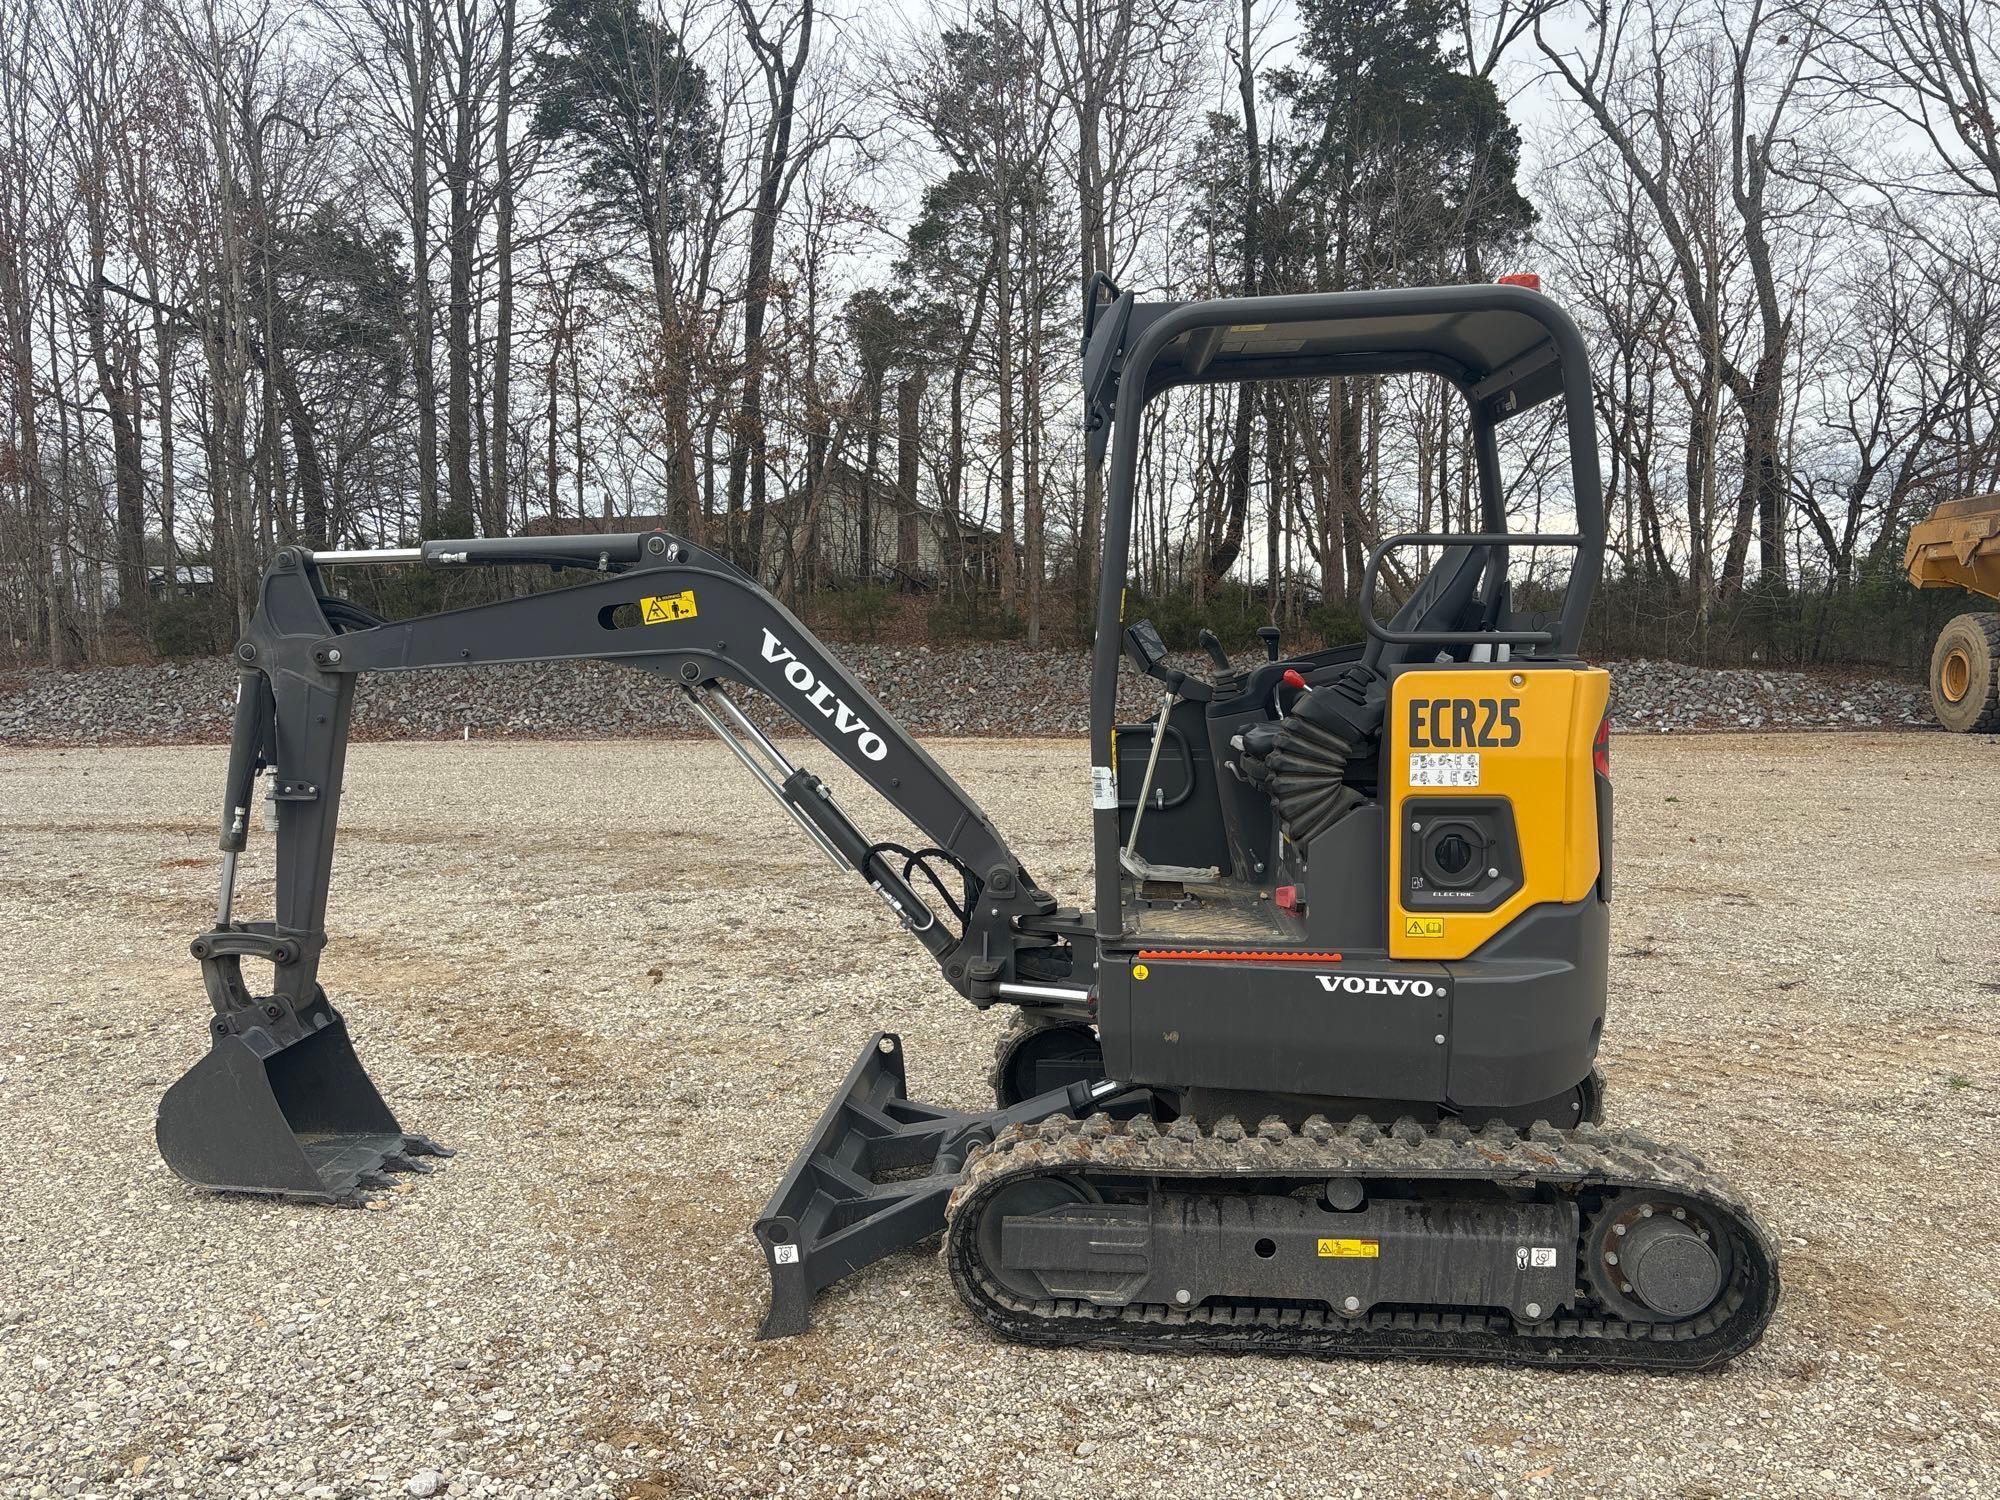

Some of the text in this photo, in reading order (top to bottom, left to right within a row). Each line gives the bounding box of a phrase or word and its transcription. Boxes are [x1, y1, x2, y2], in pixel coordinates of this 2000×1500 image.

[761, 627, 888, 761] VOLVO
[1409, 699, 1521, 748] ECR25
[1315, 975, 1434, 997] VOLVO
